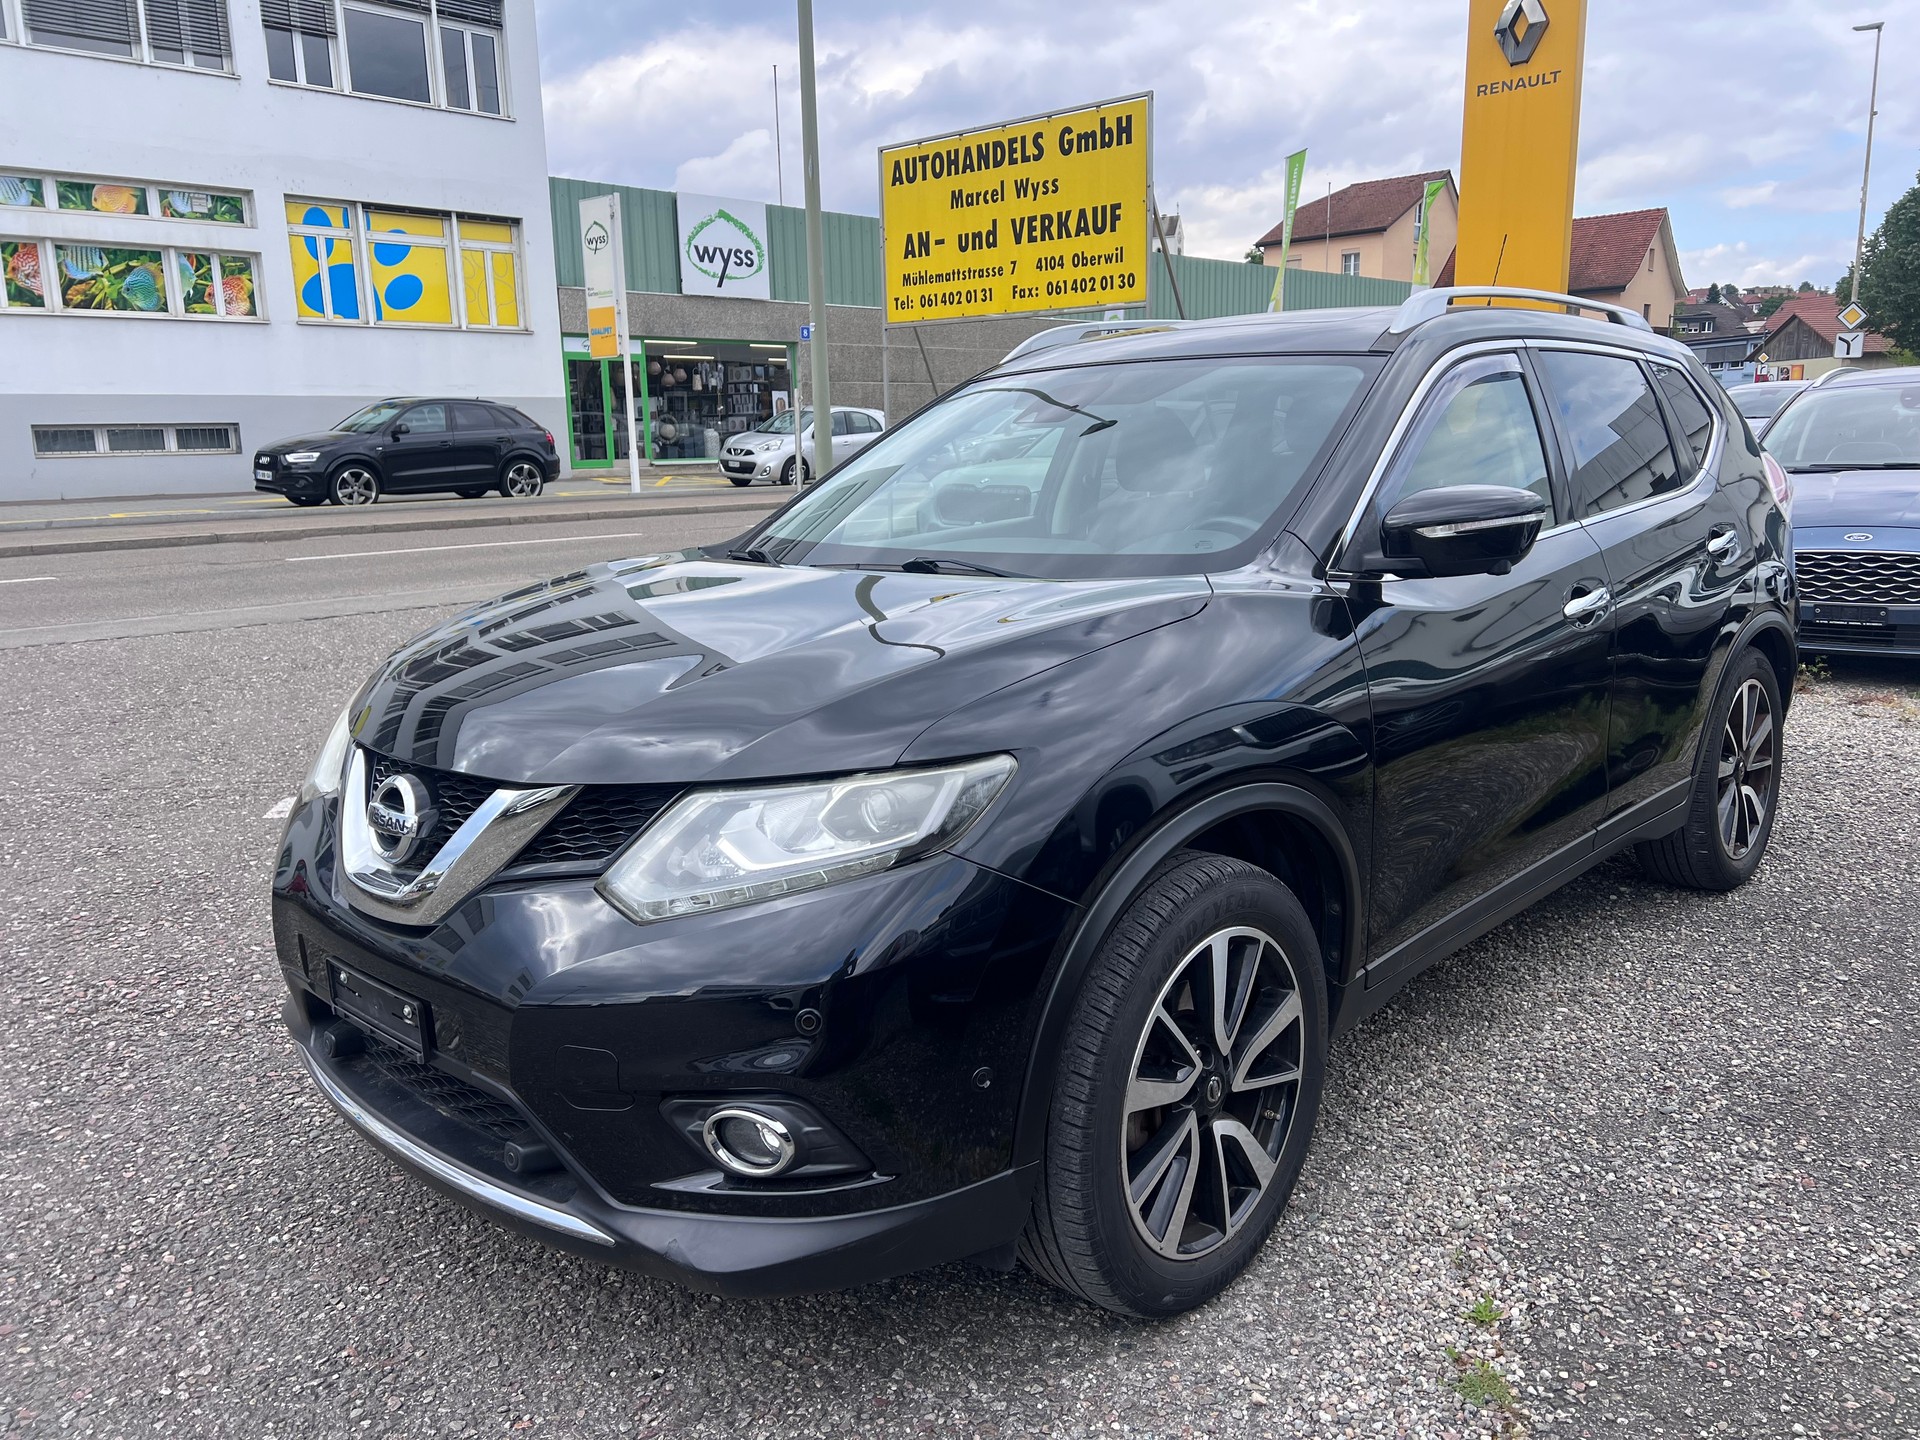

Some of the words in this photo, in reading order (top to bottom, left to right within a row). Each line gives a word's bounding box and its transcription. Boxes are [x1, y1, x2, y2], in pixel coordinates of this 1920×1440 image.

[1476, 70, 1562, 97] RENAULT
[890, 131, 1045, 187] AUTOHANDELS
[1058, 114, 1133, 157] GmbH
[950, 180, 1005, 210] Marcel
[1014, 177, 1060, 202] Wyss
[586, 234, 606, 255] wyss
[903, 230, 946, 260] AN-
[957, 218, 998, 253] und
[1010, 202, 1122, 246] VERKAUF
[693, 244, 755, 288] wyss
[902, 265, 1004, 288] Mühlemattstrasse
[1010, 260, 1018, 276] 7
[1035, 254, 1065, 272] 4104
[1071, 246, 1124, 269] Oberwil
[893, 294, 914, 311] Tel:
[1011, 284, 1039, 300] Fax:
